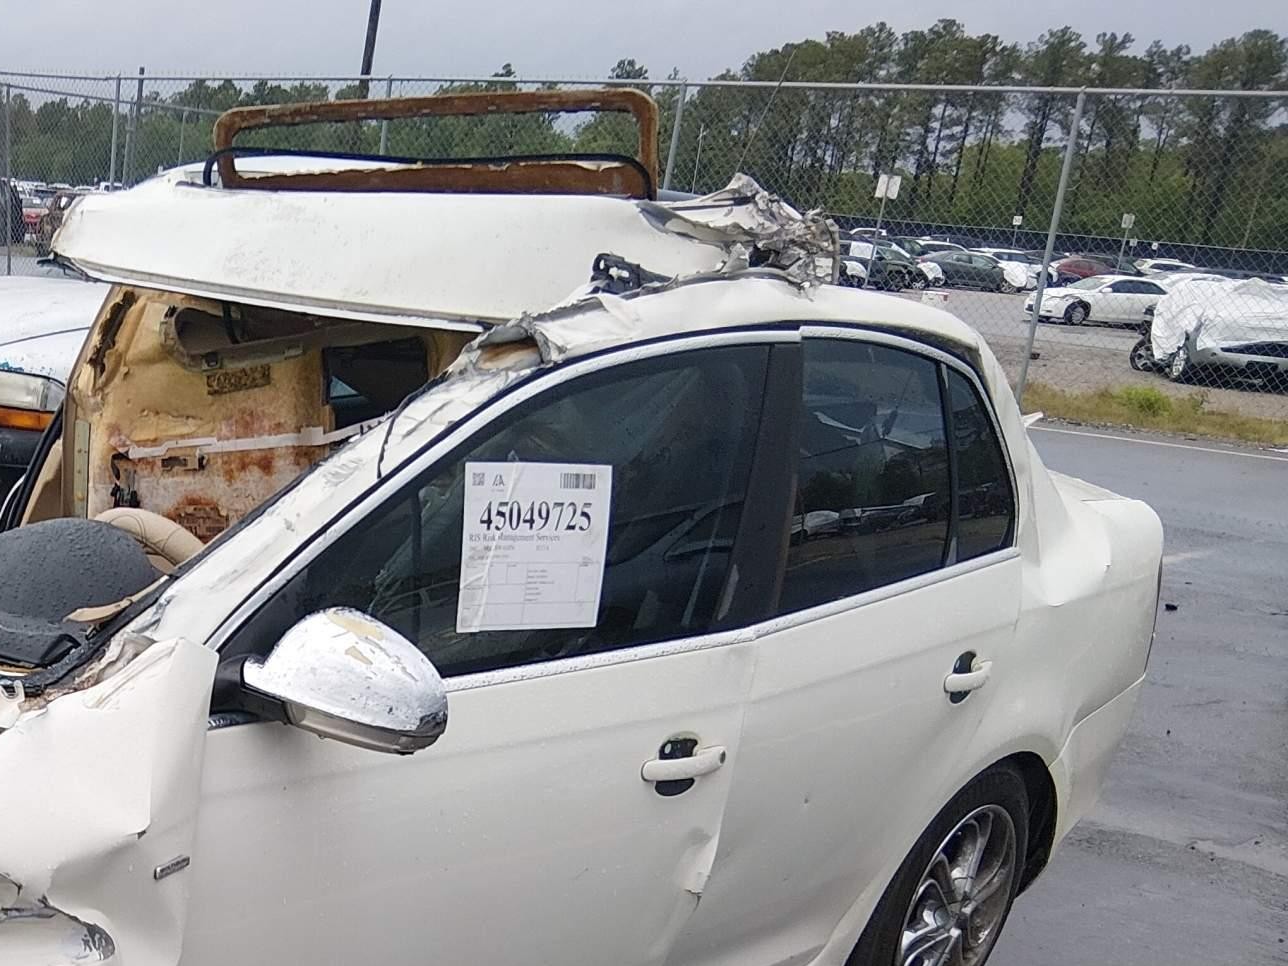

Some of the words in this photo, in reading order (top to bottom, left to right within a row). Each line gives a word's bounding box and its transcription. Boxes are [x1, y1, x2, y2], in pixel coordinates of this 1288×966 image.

[479, 500, 593, 532] 45049725
[497, 533, 535, 543] Management
[536, 533, 561, 542] Services
